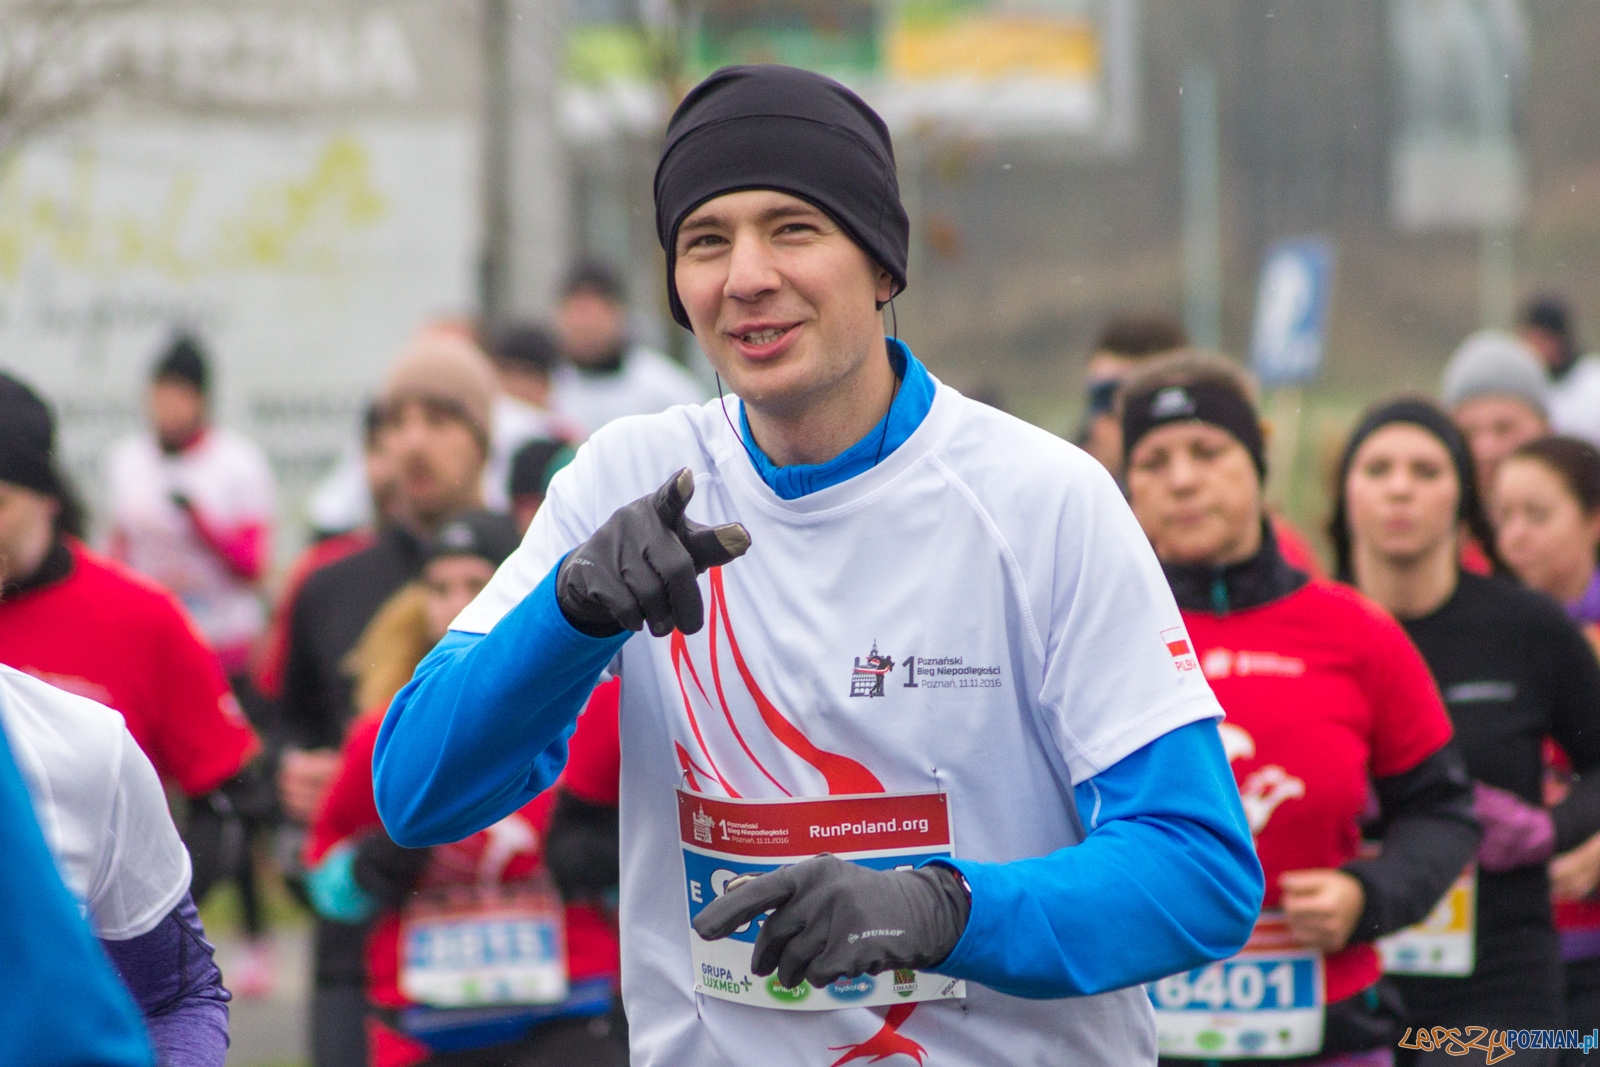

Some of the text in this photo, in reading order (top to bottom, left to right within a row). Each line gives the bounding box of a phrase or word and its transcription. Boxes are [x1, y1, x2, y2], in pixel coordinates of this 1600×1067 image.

[902, 655, 963, 688] 1 Poznański
[917, 665, 1001, 677] Bieg Niepodległości
[922, 678, 1002, 689] Poznań, 11.11.2016
[718, 819, 758, 841] 1 Poznański
[727, 828, 789, 837] Bieg Niepodległości
[809, 818, 929, 839] RunPoland.org
[690, 879, 703, 904] E
[861, 928, 903, 939] DUNLOP
[701, 962, 733, 981] GRUPA
[702, 974, 741, 995] LUXMED
[1156, 963, 1295, 1008] 6401
